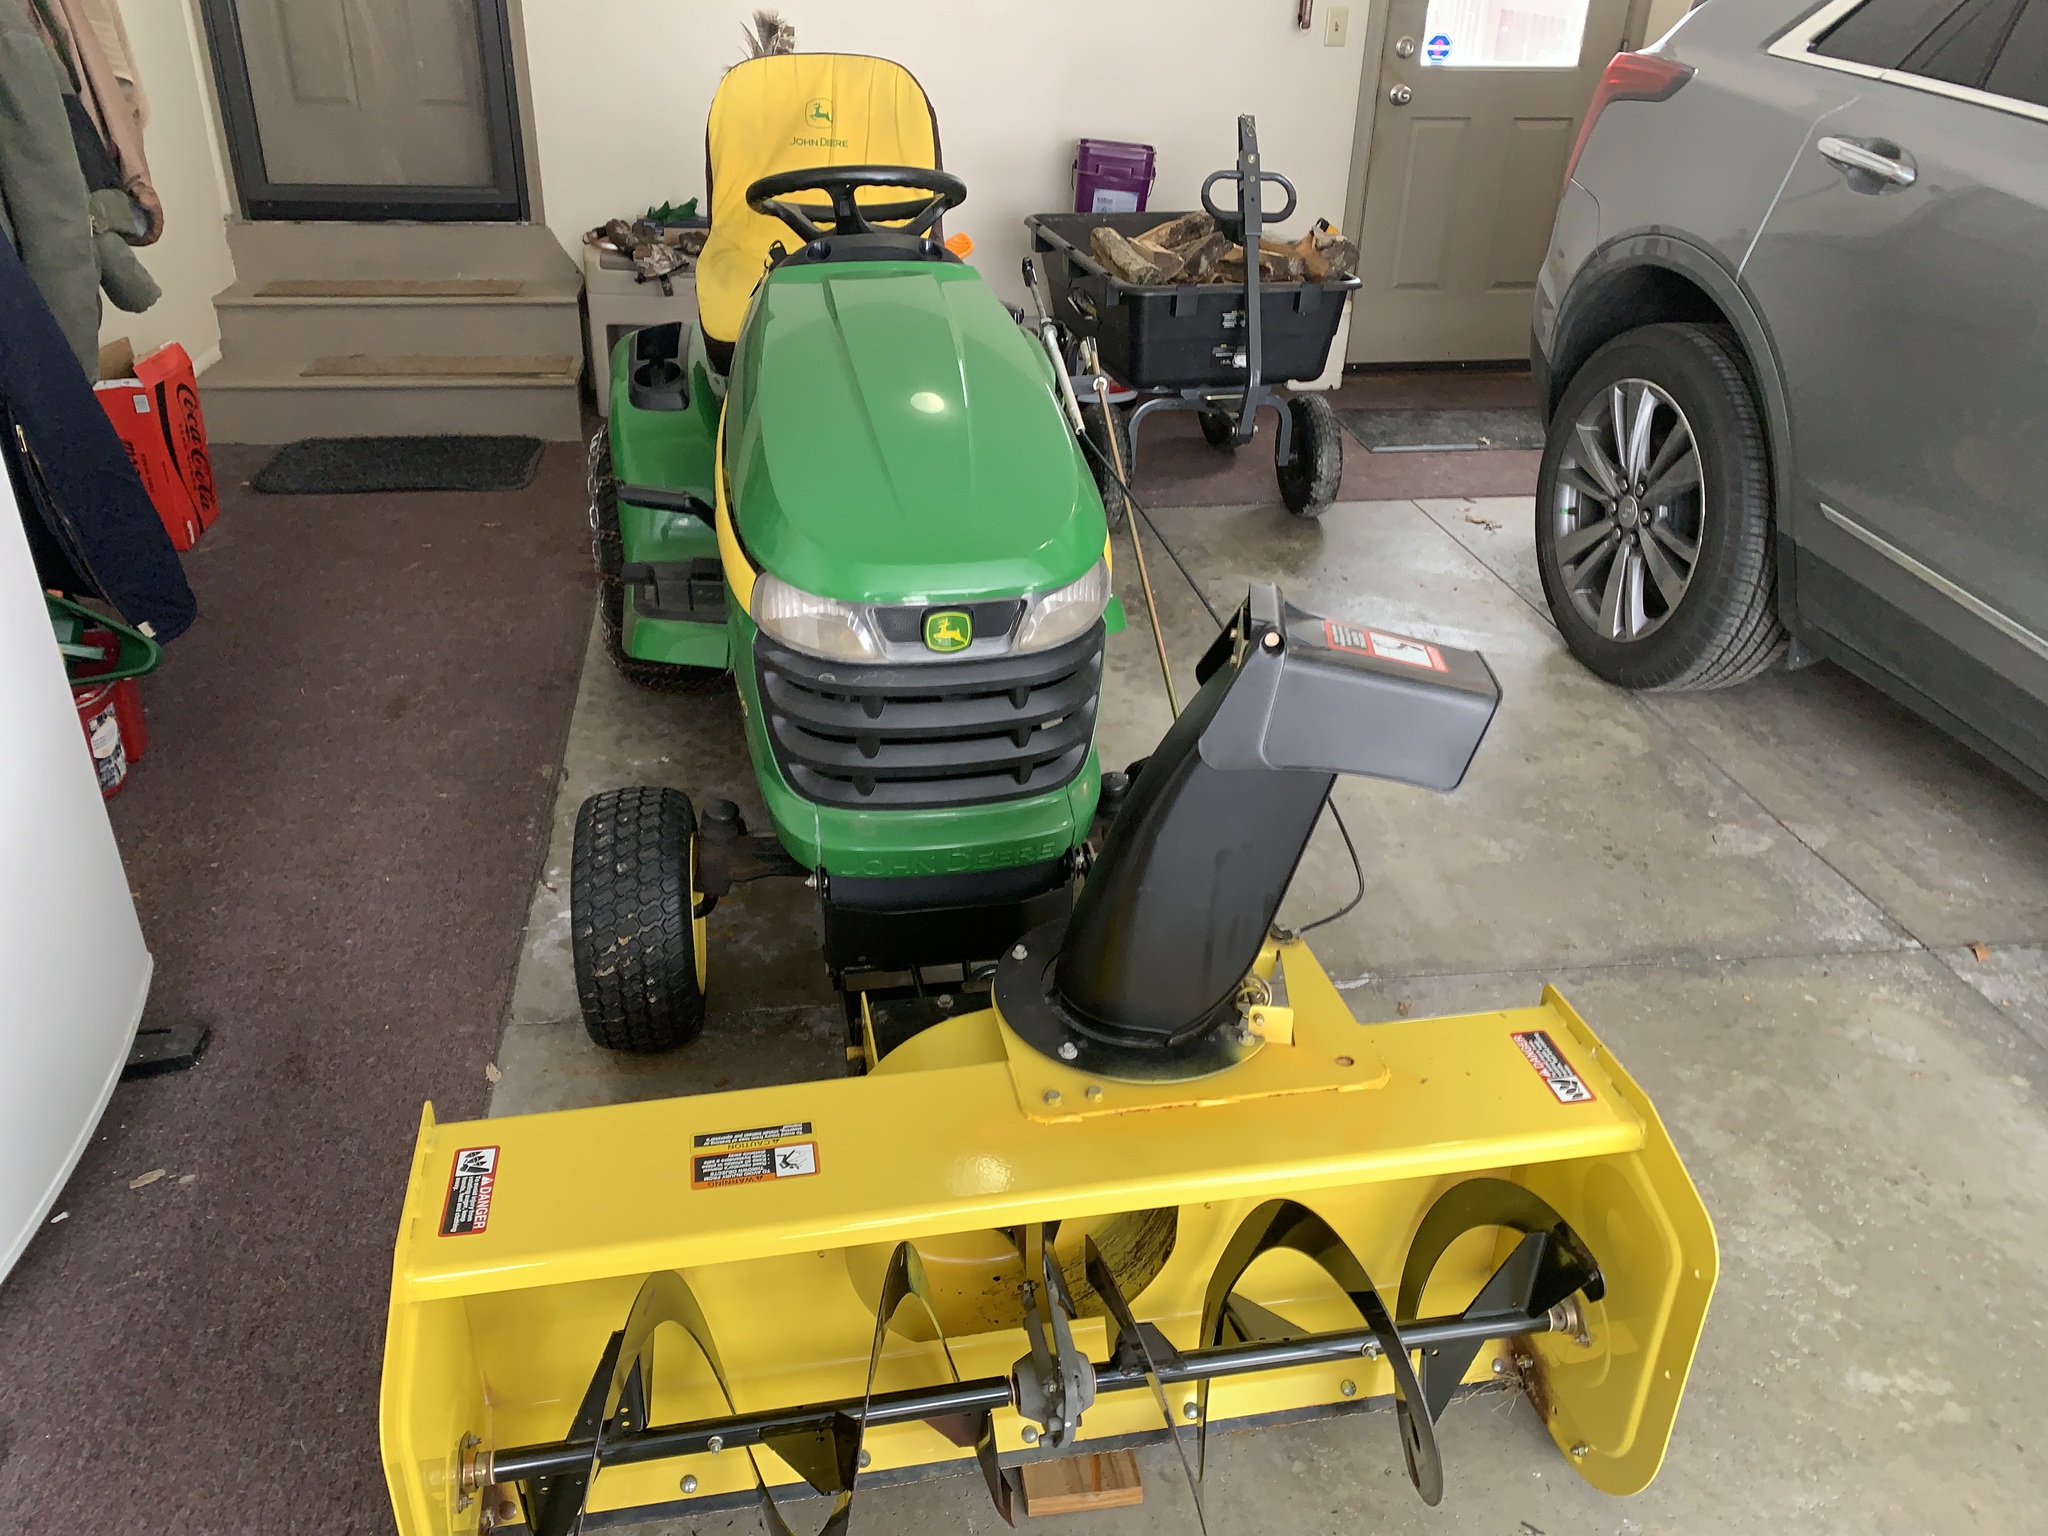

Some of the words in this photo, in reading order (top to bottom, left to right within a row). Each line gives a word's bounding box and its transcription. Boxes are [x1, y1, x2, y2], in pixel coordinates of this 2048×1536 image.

[791, 136, 819, 146] JOHN
[819, 137, 849, 148] DEERE
[840, 853, 936, 876] JOHN
[946, 841, 1056, 872] DEERE
[1513, 1034, 1544, 1069] DANGER
[728, 1140, 770, 1150] CAUTION
[709, 1168, 737, 1176] OBJECTS
[708, 1177, 753, 1187] WARNING
[472, 1186, 491, 1229] DANGER
